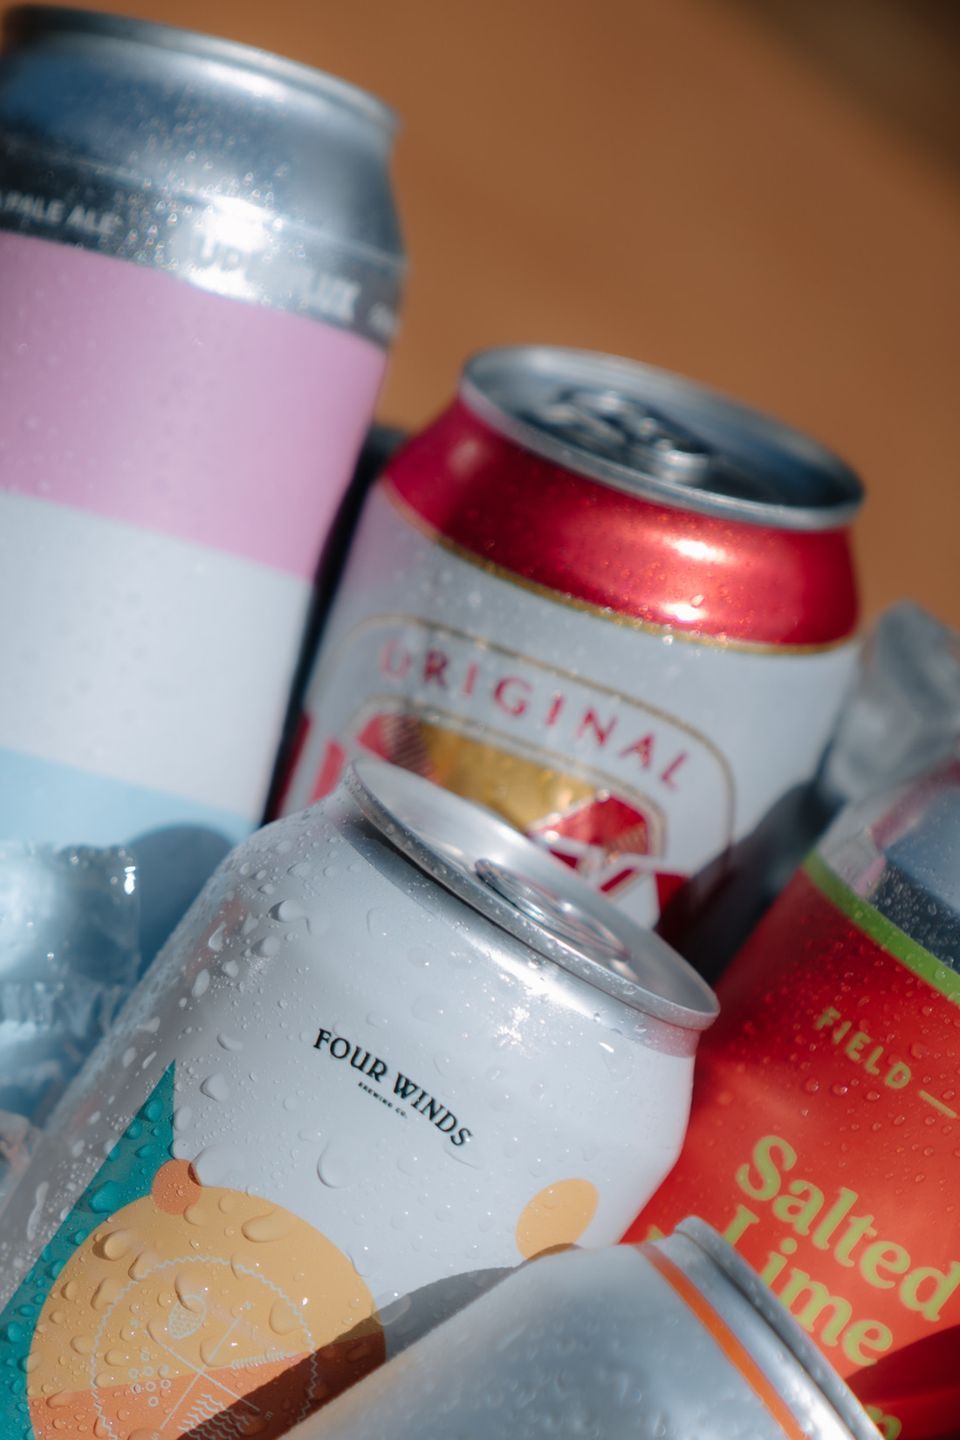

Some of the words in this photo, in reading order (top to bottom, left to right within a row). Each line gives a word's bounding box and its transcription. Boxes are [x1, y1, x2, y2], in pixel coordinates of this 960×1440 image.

[4, 190, 65, 224] PALE
[378, 639, 689, 789] ORIGINAL
[313, 1028, 388, 1083] FOUR
[393, 1072, 473, 1146] WINDS
[814, 1006, 912, 1088] FIELD
[736, 1135, 960, 1321] Salted
